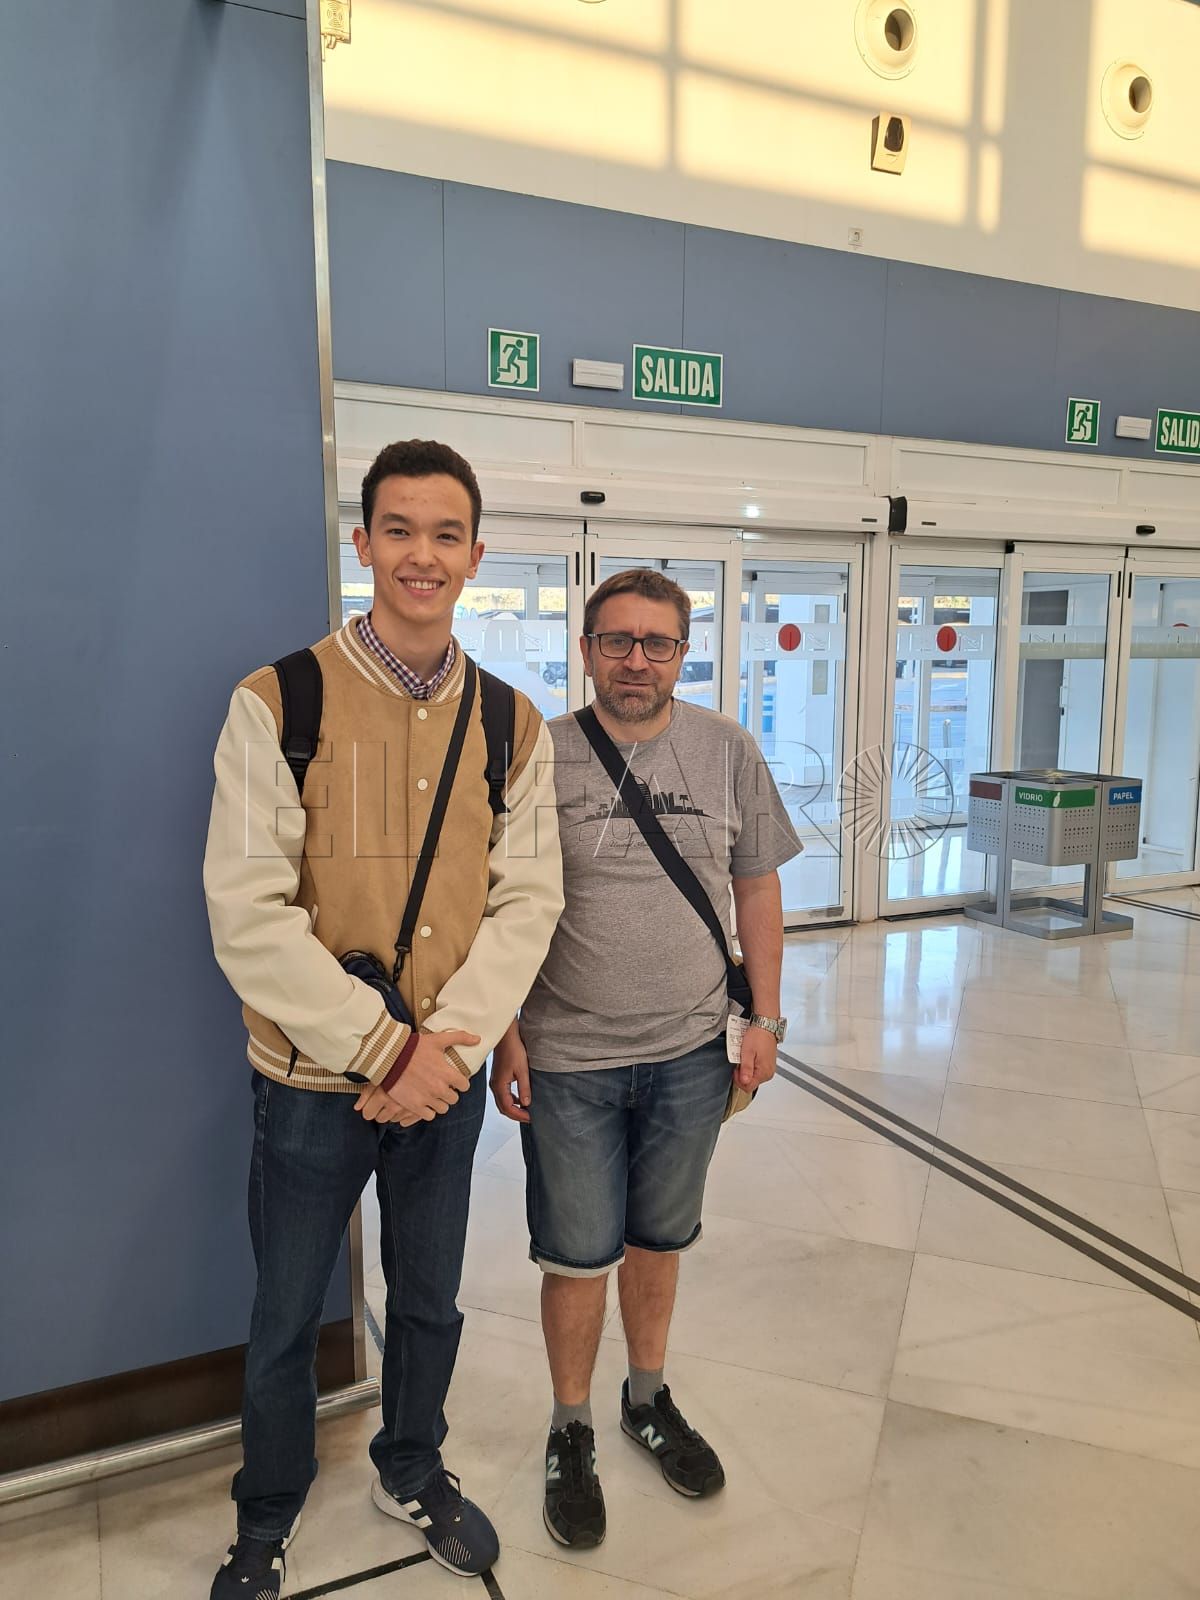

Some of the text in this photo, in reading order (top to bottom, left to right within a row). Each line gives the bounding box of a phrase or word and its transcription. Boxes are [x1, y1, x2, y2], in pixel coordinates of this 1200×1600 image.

[641, 354, 715, 398] SALIDA
[1160, 416, 1200, 449] SALID
[1018, 791, 1044, 802] VIDRIO
[1113, 791, 1134, 801] PAPEL
